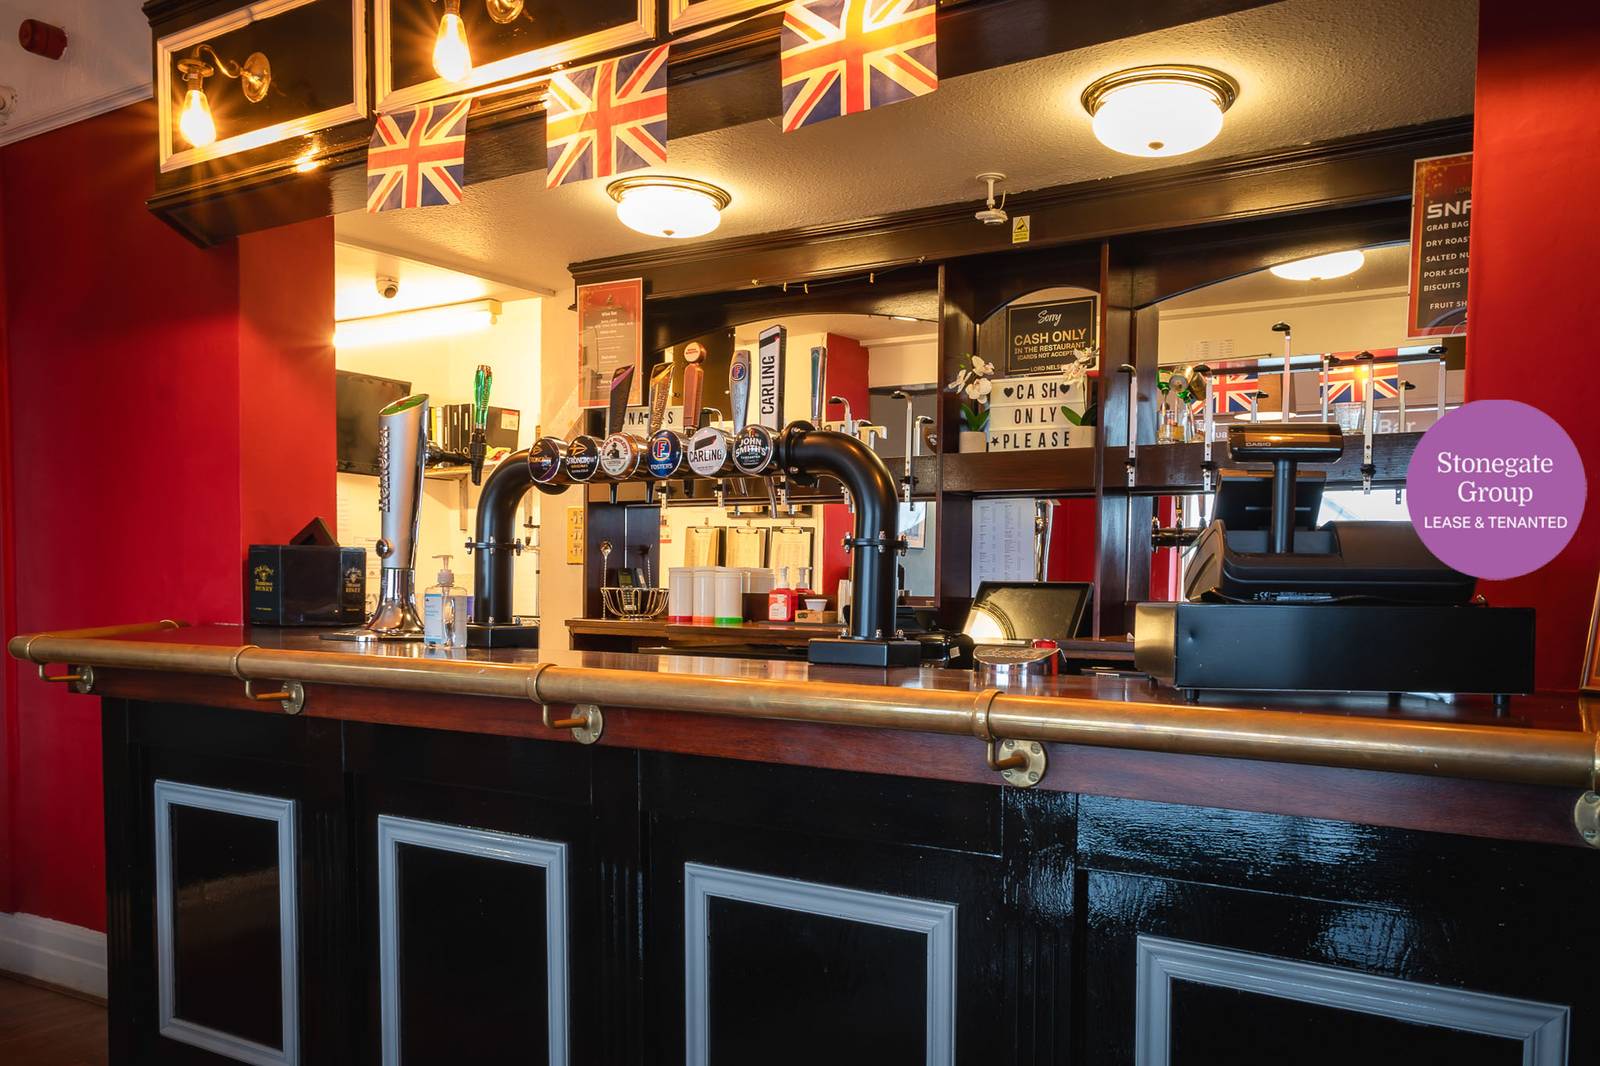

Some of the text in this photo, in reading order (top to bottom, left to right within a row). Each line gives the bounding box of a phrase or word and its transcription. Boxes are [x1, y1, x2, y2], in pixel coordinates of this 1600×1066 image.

[1426, 200, 1472, 219] SNA
[1426, 222, 1449, 232] GRAB
[1425, 236, 1470, 248] DRY ROAS
[1425, 253, 1457, 263] SALTED
[1423, 266, 1470, 279] PORK SCRA
[1423, 281, 1461, 292] BISCUITS
[1429, 301, 1454, 310] FRUIT
[1038, 309, 1062, 327] Sorry
[1014, 328, 1087, 346] CASH ONLY
[1014, 341, 1086, 355] IN THE RESTAURANT
[1051, 350, 1074, 358] ACCEPT
[1046, 363, 1060, 371] NELS
[761, 355, 775, 415] CARLING
[1016, 382, 1057, 400] CASH
[1014, 406, 1057, 424] ONLY
[739, 437, 762, 447] JOHN
[1003, 431, 1070, 449] PLEASE
[689, 449, 722, 463] CARLING
